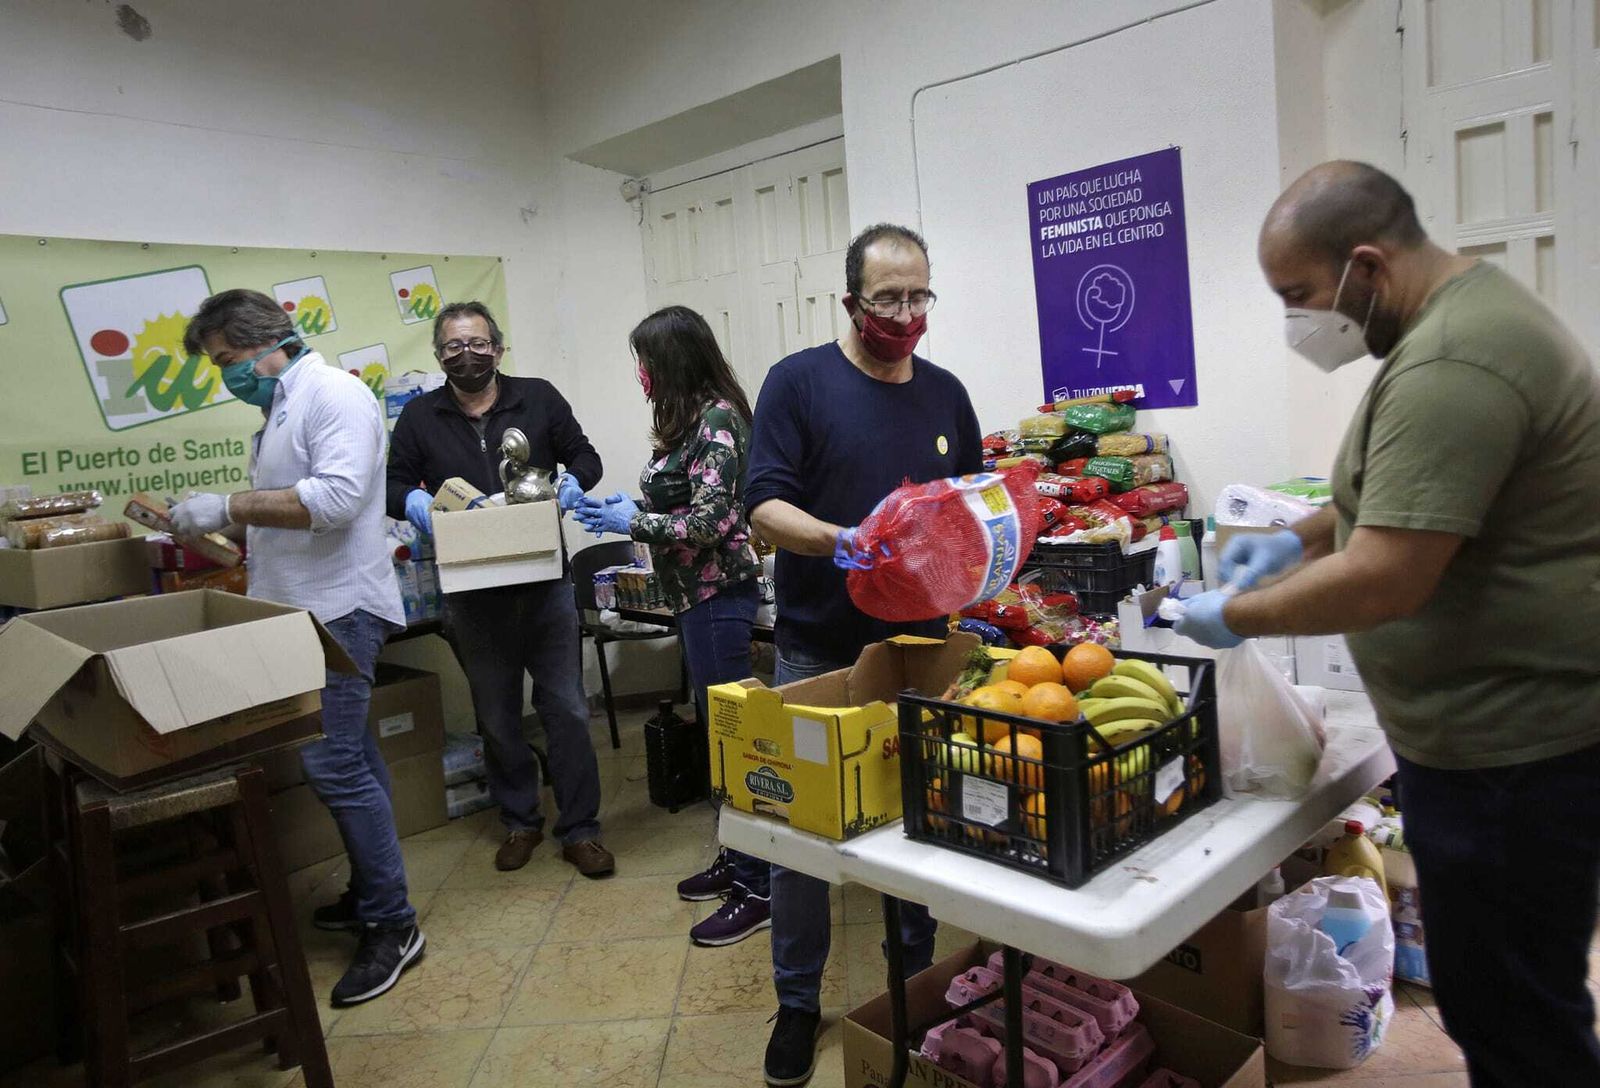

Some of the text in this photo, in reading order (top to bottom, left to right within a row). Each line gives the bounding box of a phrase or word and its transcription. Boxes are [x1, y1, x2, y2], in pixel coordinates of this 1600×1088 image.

[1038, 168, 1142, 205] UN PAÍS QUE LUCHA
[1040, 187, 1142, 223] POR UNA SOCIEDAD
[1041, 201, 1172, 241] FEMINISTA QUE PONGA
[1042, 222, 1164, 258] LA VIDA EN EL CENTRO
[22, 438, 244, 475] El Puerto de Santa
